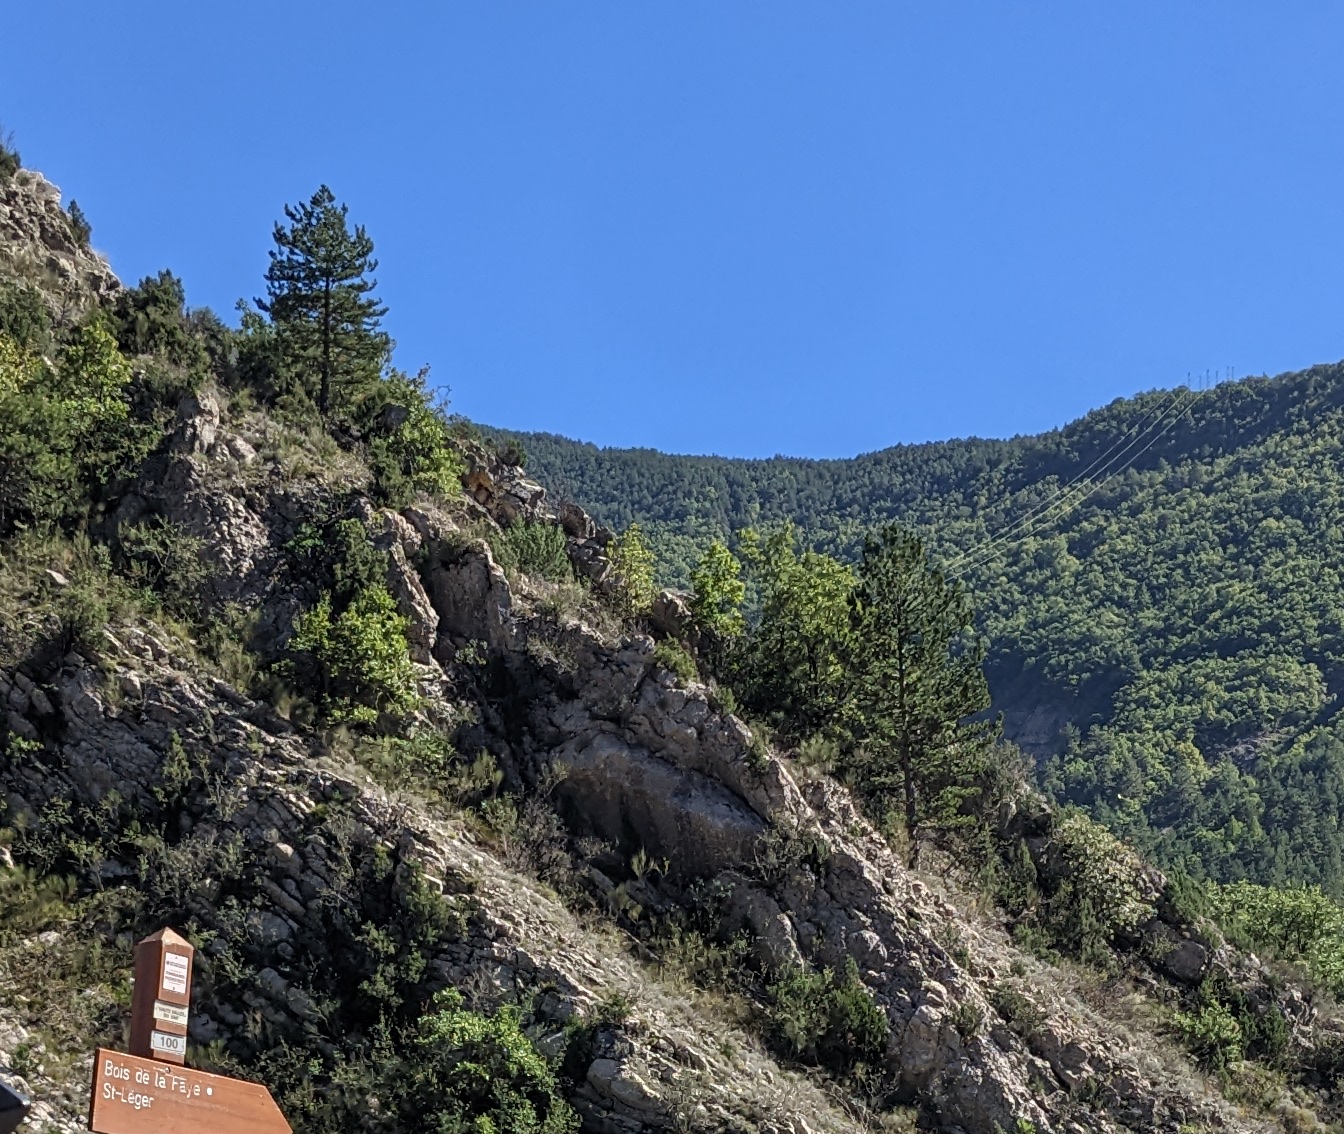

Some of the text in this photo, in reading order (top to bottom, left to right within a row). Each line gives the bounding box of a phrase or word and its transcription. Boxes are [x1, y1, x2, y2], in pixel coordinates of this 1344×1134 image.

[160, 1036, 178, 1049] 100
[104, 1060, 201, 1099] Bois de la Faye
[102, 1082, 155, 1110] St-Léger
